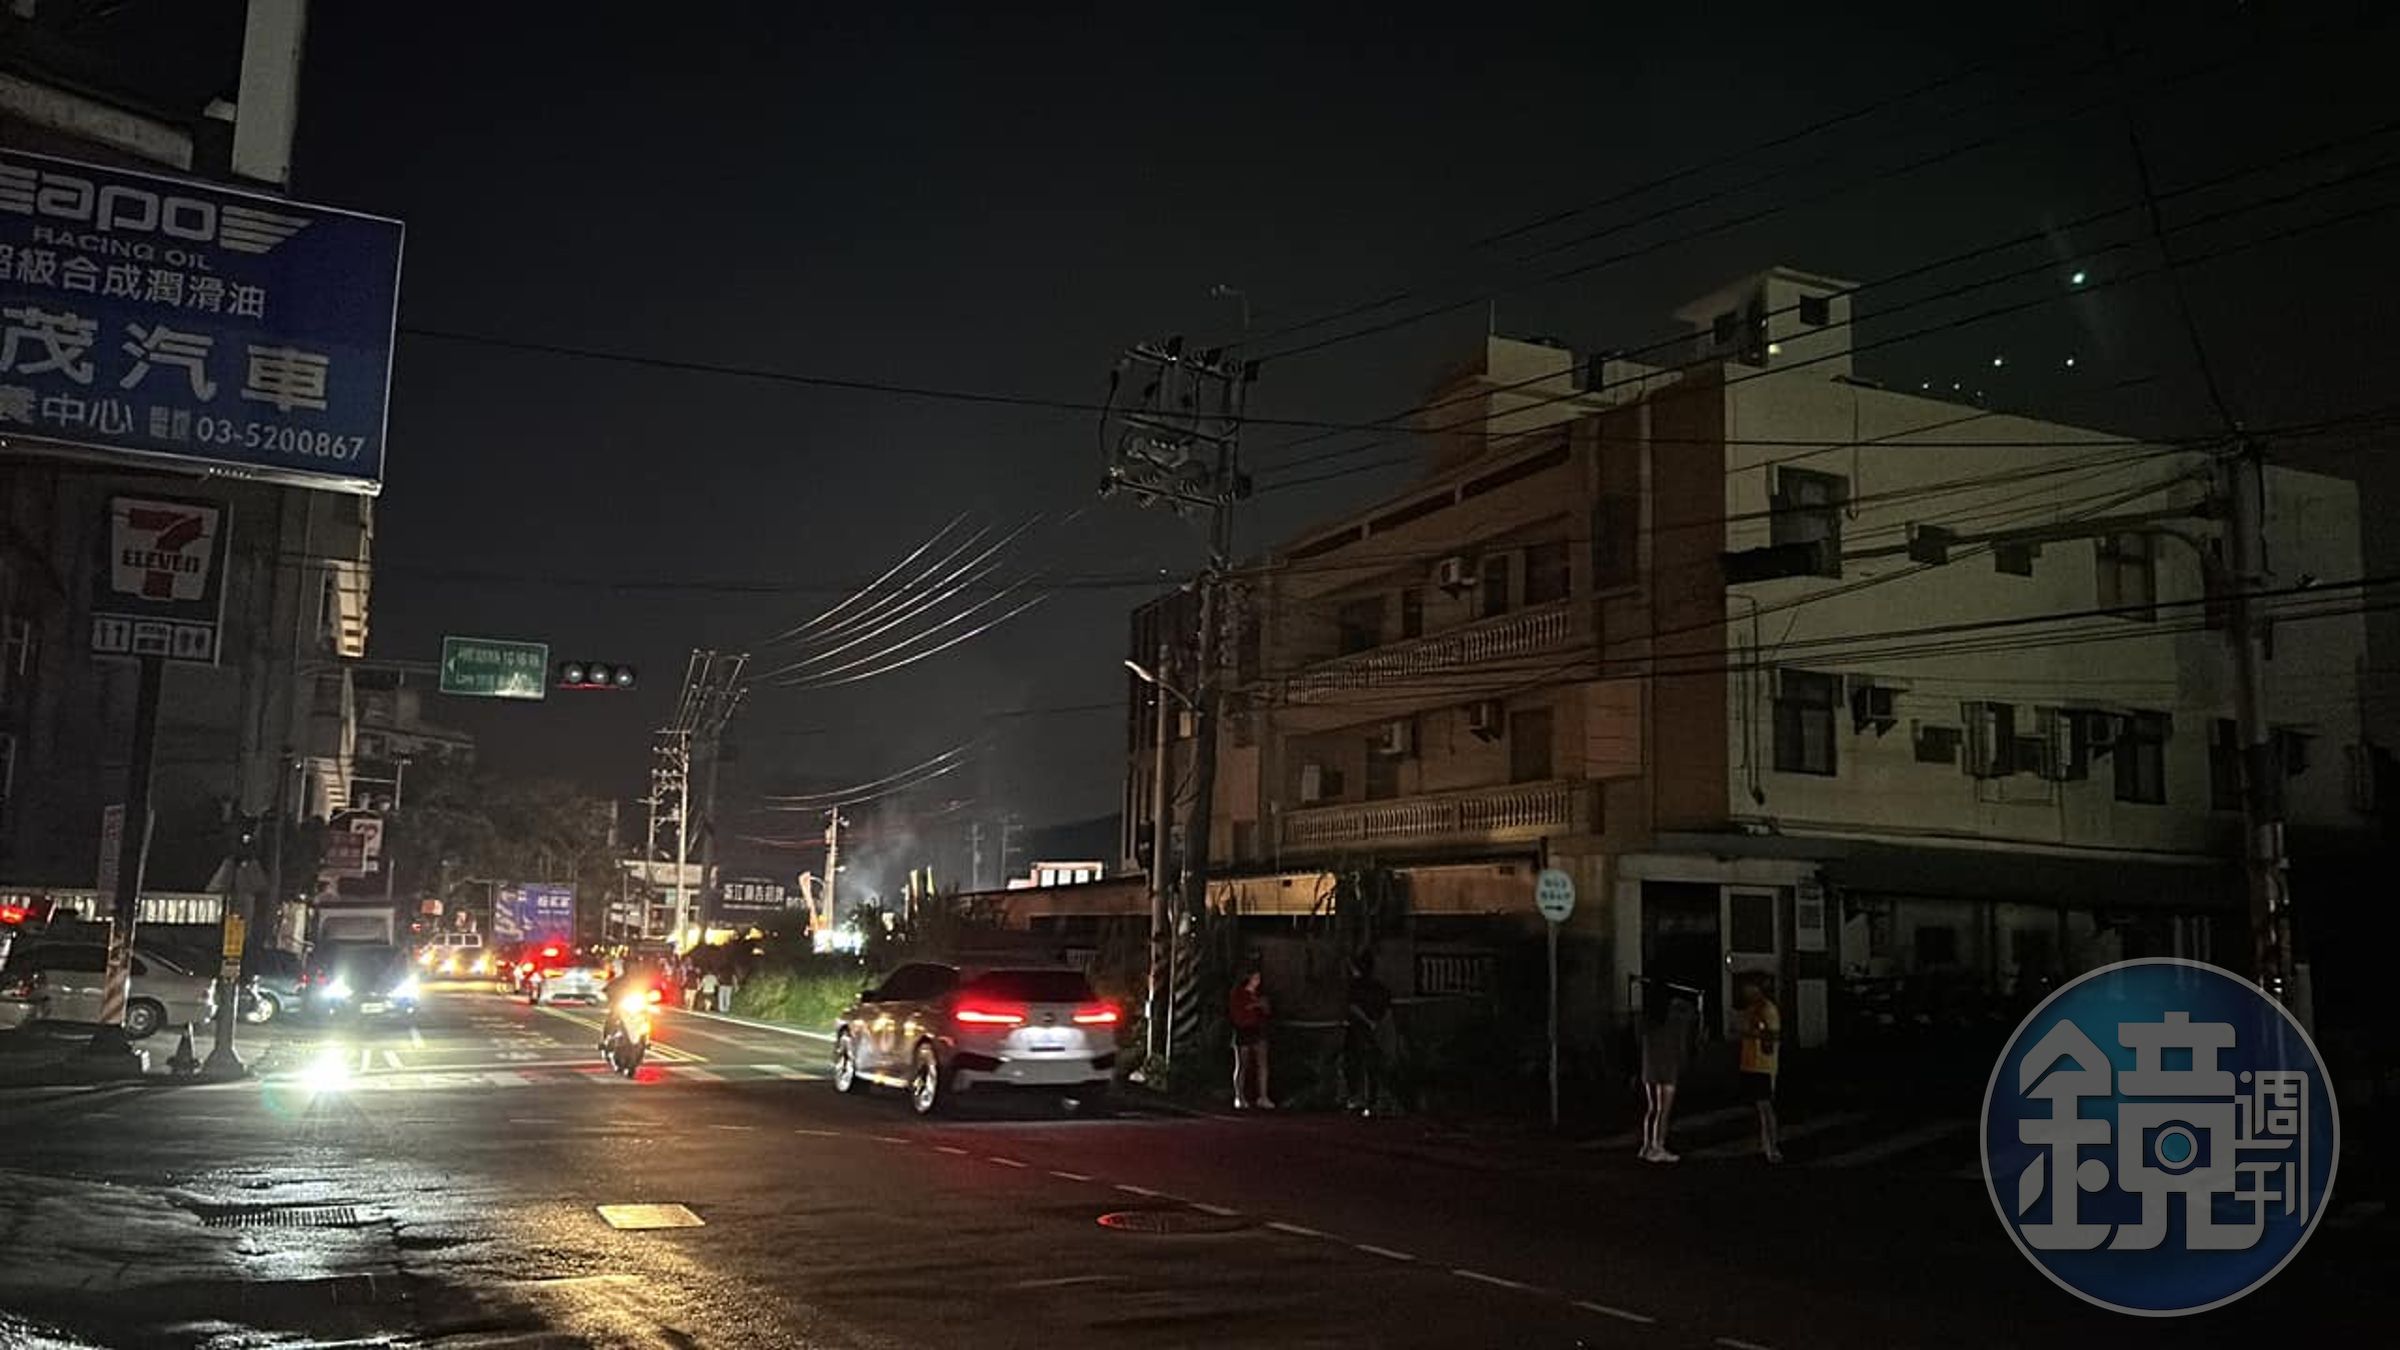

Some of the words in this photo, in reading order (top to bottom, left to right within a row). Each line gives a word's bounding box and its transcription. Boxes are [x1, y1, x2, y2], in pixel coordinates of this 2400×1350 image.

[33, 225, 154, 261] RACING
[165, 249, 212, 272] OIL
[197, 417, 366, 462] 03-5200867
